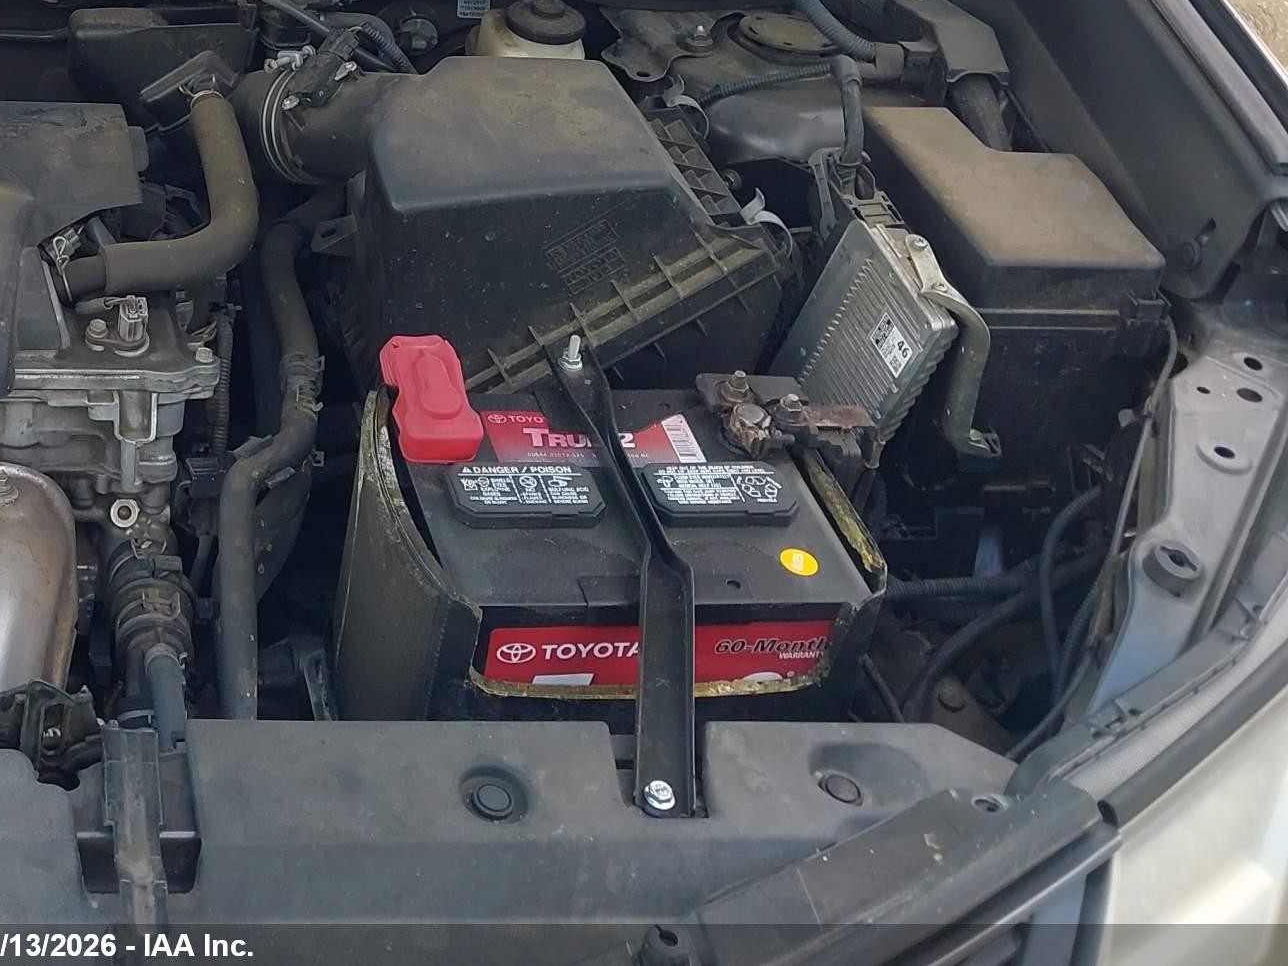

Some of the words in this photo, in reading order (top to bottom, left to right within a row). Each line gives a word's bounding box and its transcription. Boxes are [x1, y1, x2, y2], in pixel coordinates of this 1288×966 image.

[897, 340, 910, 359] 46
[509, 415, 545, 424] TOYO
[473, 466, 520, 474] DANGER
[530, 465, 573, 474] POISON
[714, 636, 829, 655] 60-Month
